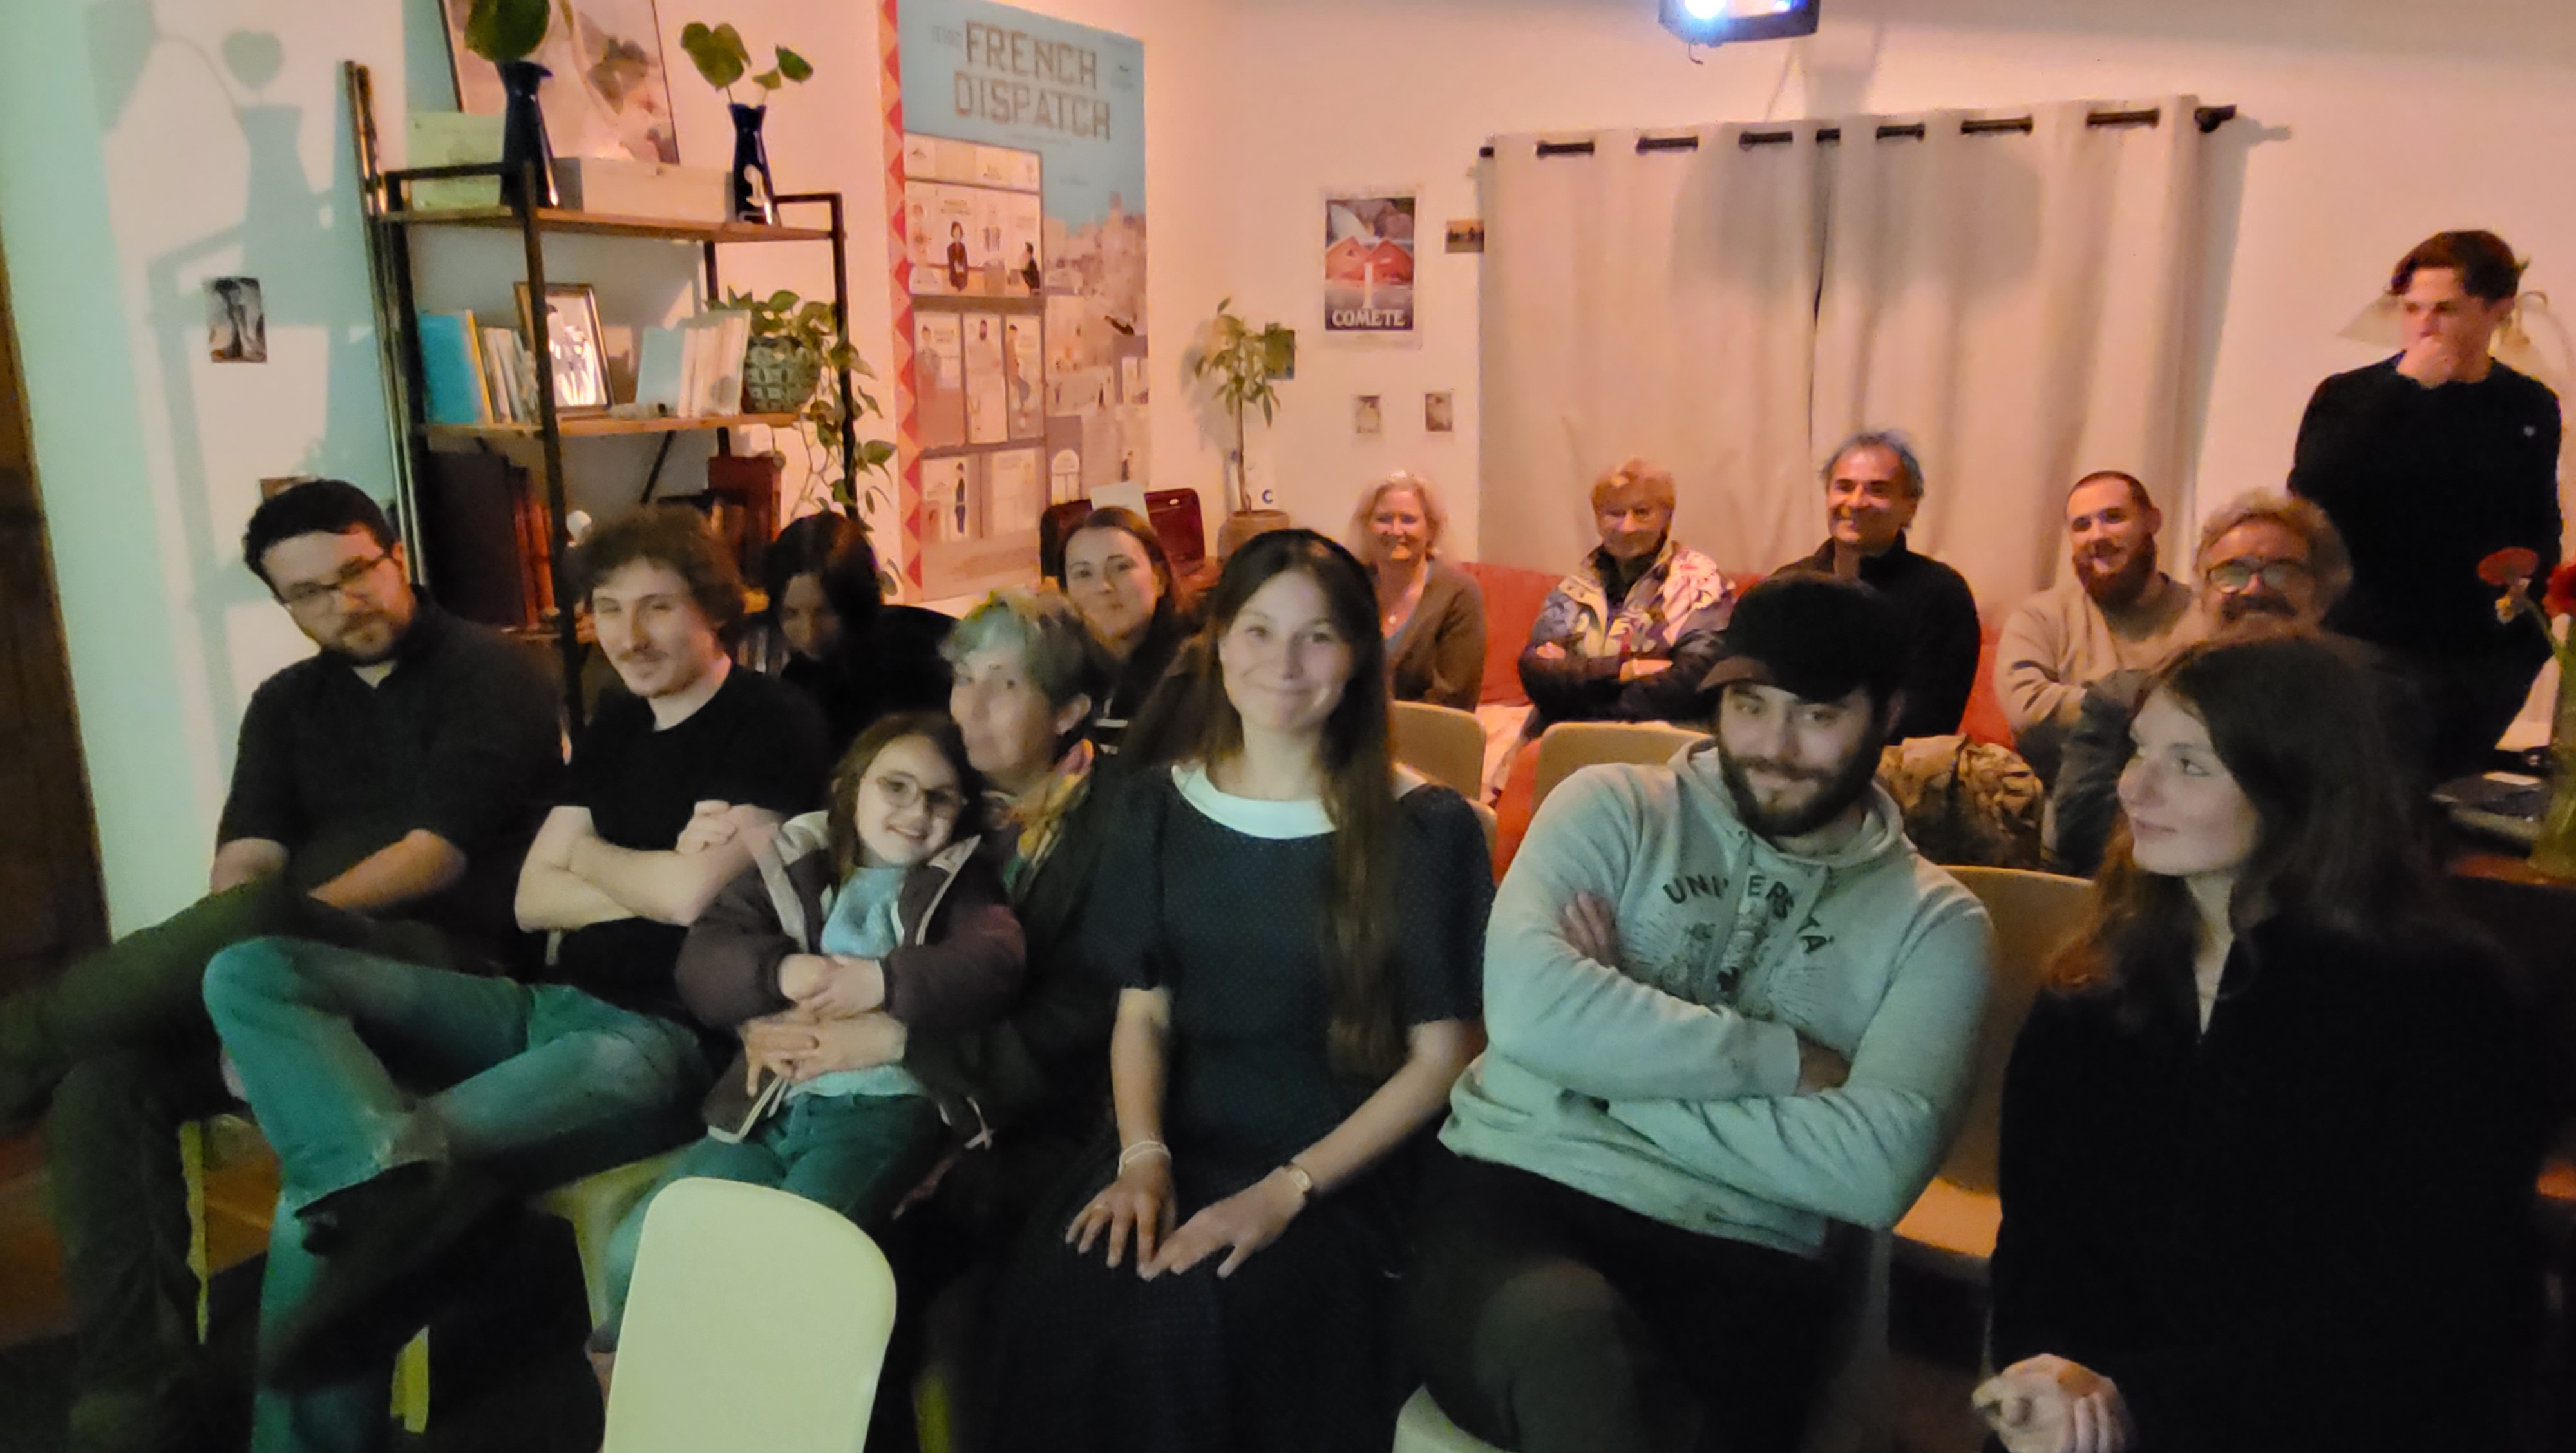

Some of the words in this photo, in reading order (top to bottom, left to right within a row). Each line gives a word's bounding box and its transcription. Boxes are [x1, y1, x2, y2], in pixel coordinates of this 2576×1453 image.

[965, 21, 1097, 90] FRENCH
[954, 71, 1110, 142] DISPATCH
[1332, 309, 1405, 327] COMETE
